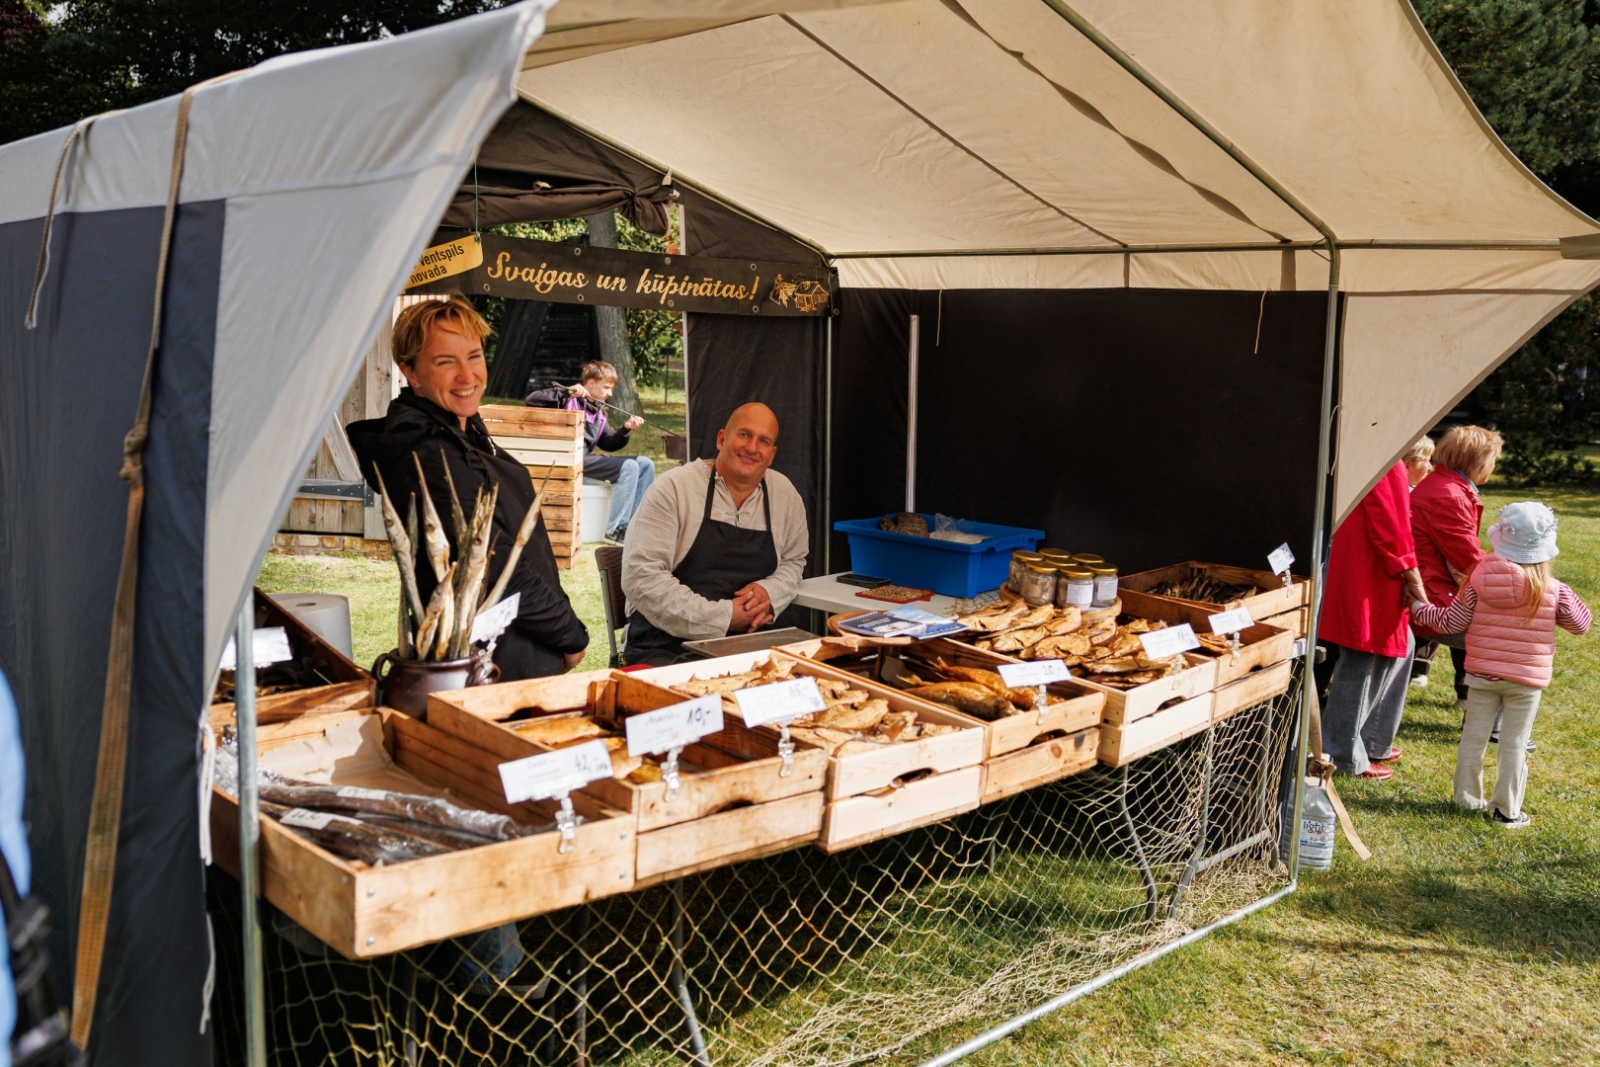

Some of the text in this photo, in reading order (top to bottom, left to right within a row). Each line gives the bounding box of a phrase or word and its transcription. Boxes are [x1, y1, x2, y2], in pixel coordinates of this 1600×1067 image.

[419, 243, 465, 266] Ventspils
[410, 264, 447, 284] novada
[487, 251, 760, 305] Svaigas un kūpinātas!
[1303, 820, 1326, 834] light
